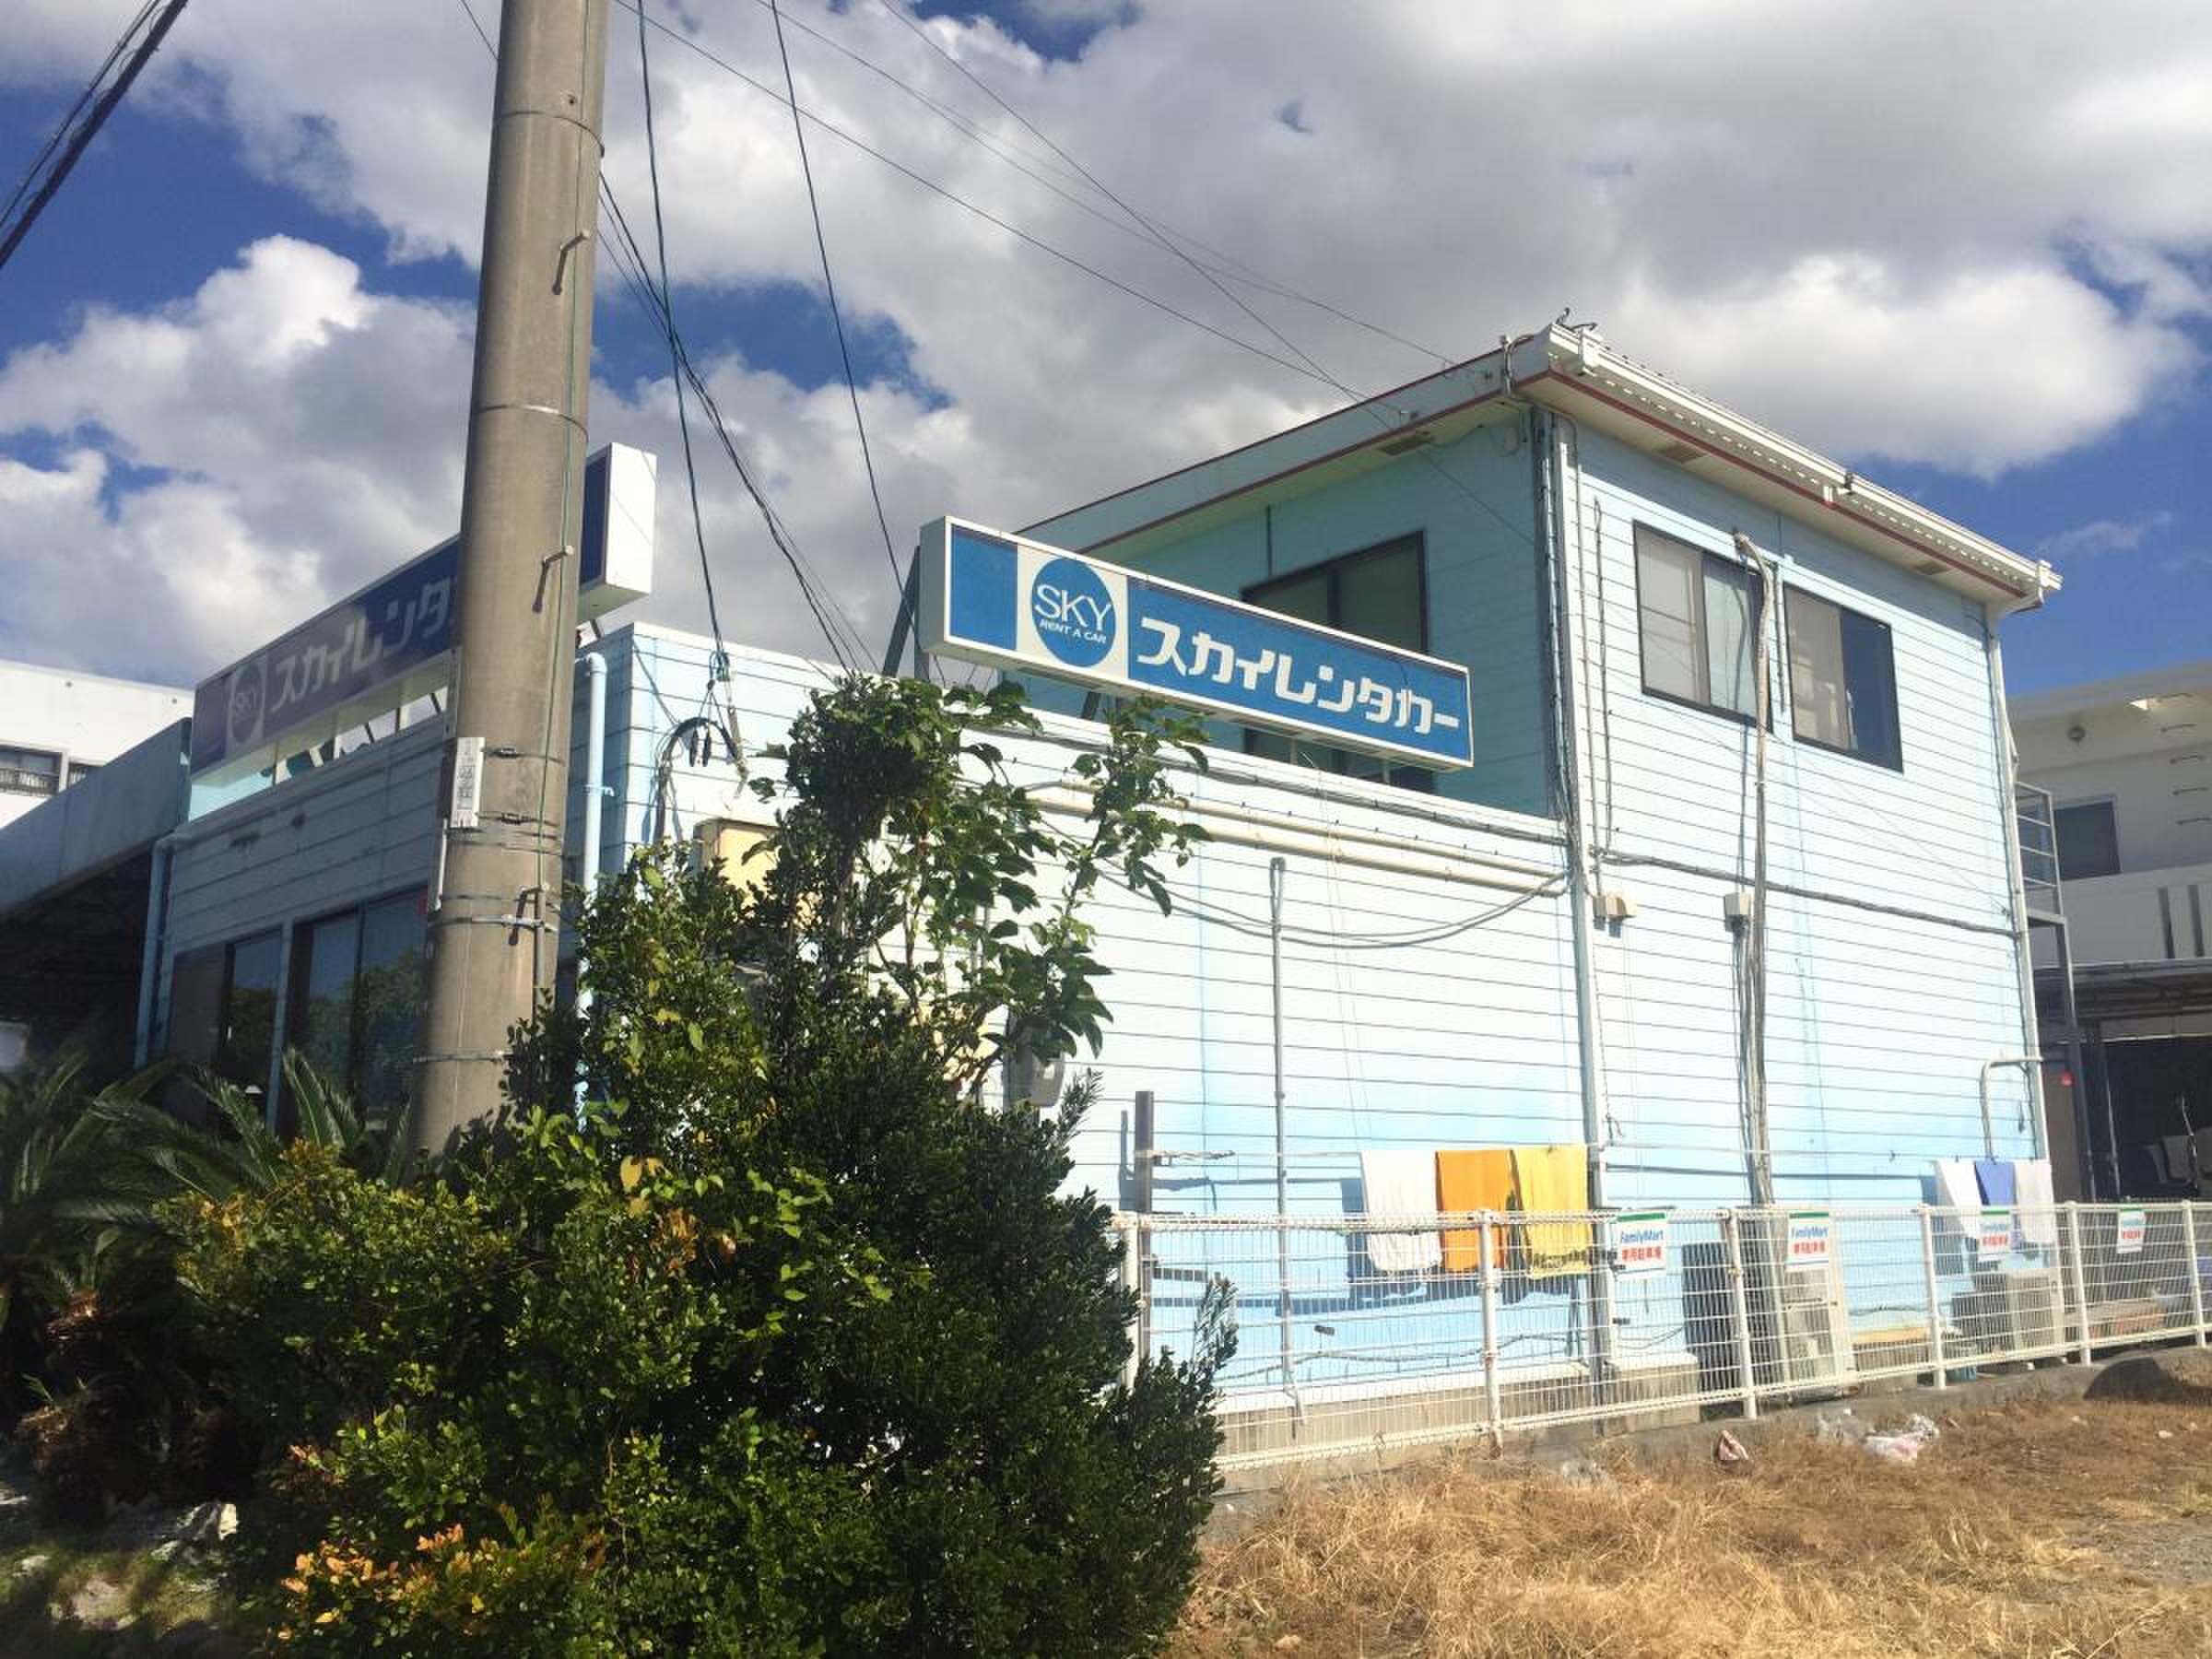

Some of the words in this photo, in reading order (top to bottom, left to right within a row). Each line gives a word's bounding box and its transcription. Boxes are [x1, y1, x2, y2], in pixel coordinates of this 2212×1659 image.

[1034, 583, 1112, 631] SKY
[1040, 618, 1072, 635] RENT
[1072, 629, 1082, 639] A
[1083, 632, 1108, 644] CAR
[271, 576, 457, 712] スカイレンタ
[1136, 617, 1459, 735] スカイレンタカー
[1620, 1230, 1664, 1243] FamilyMart
